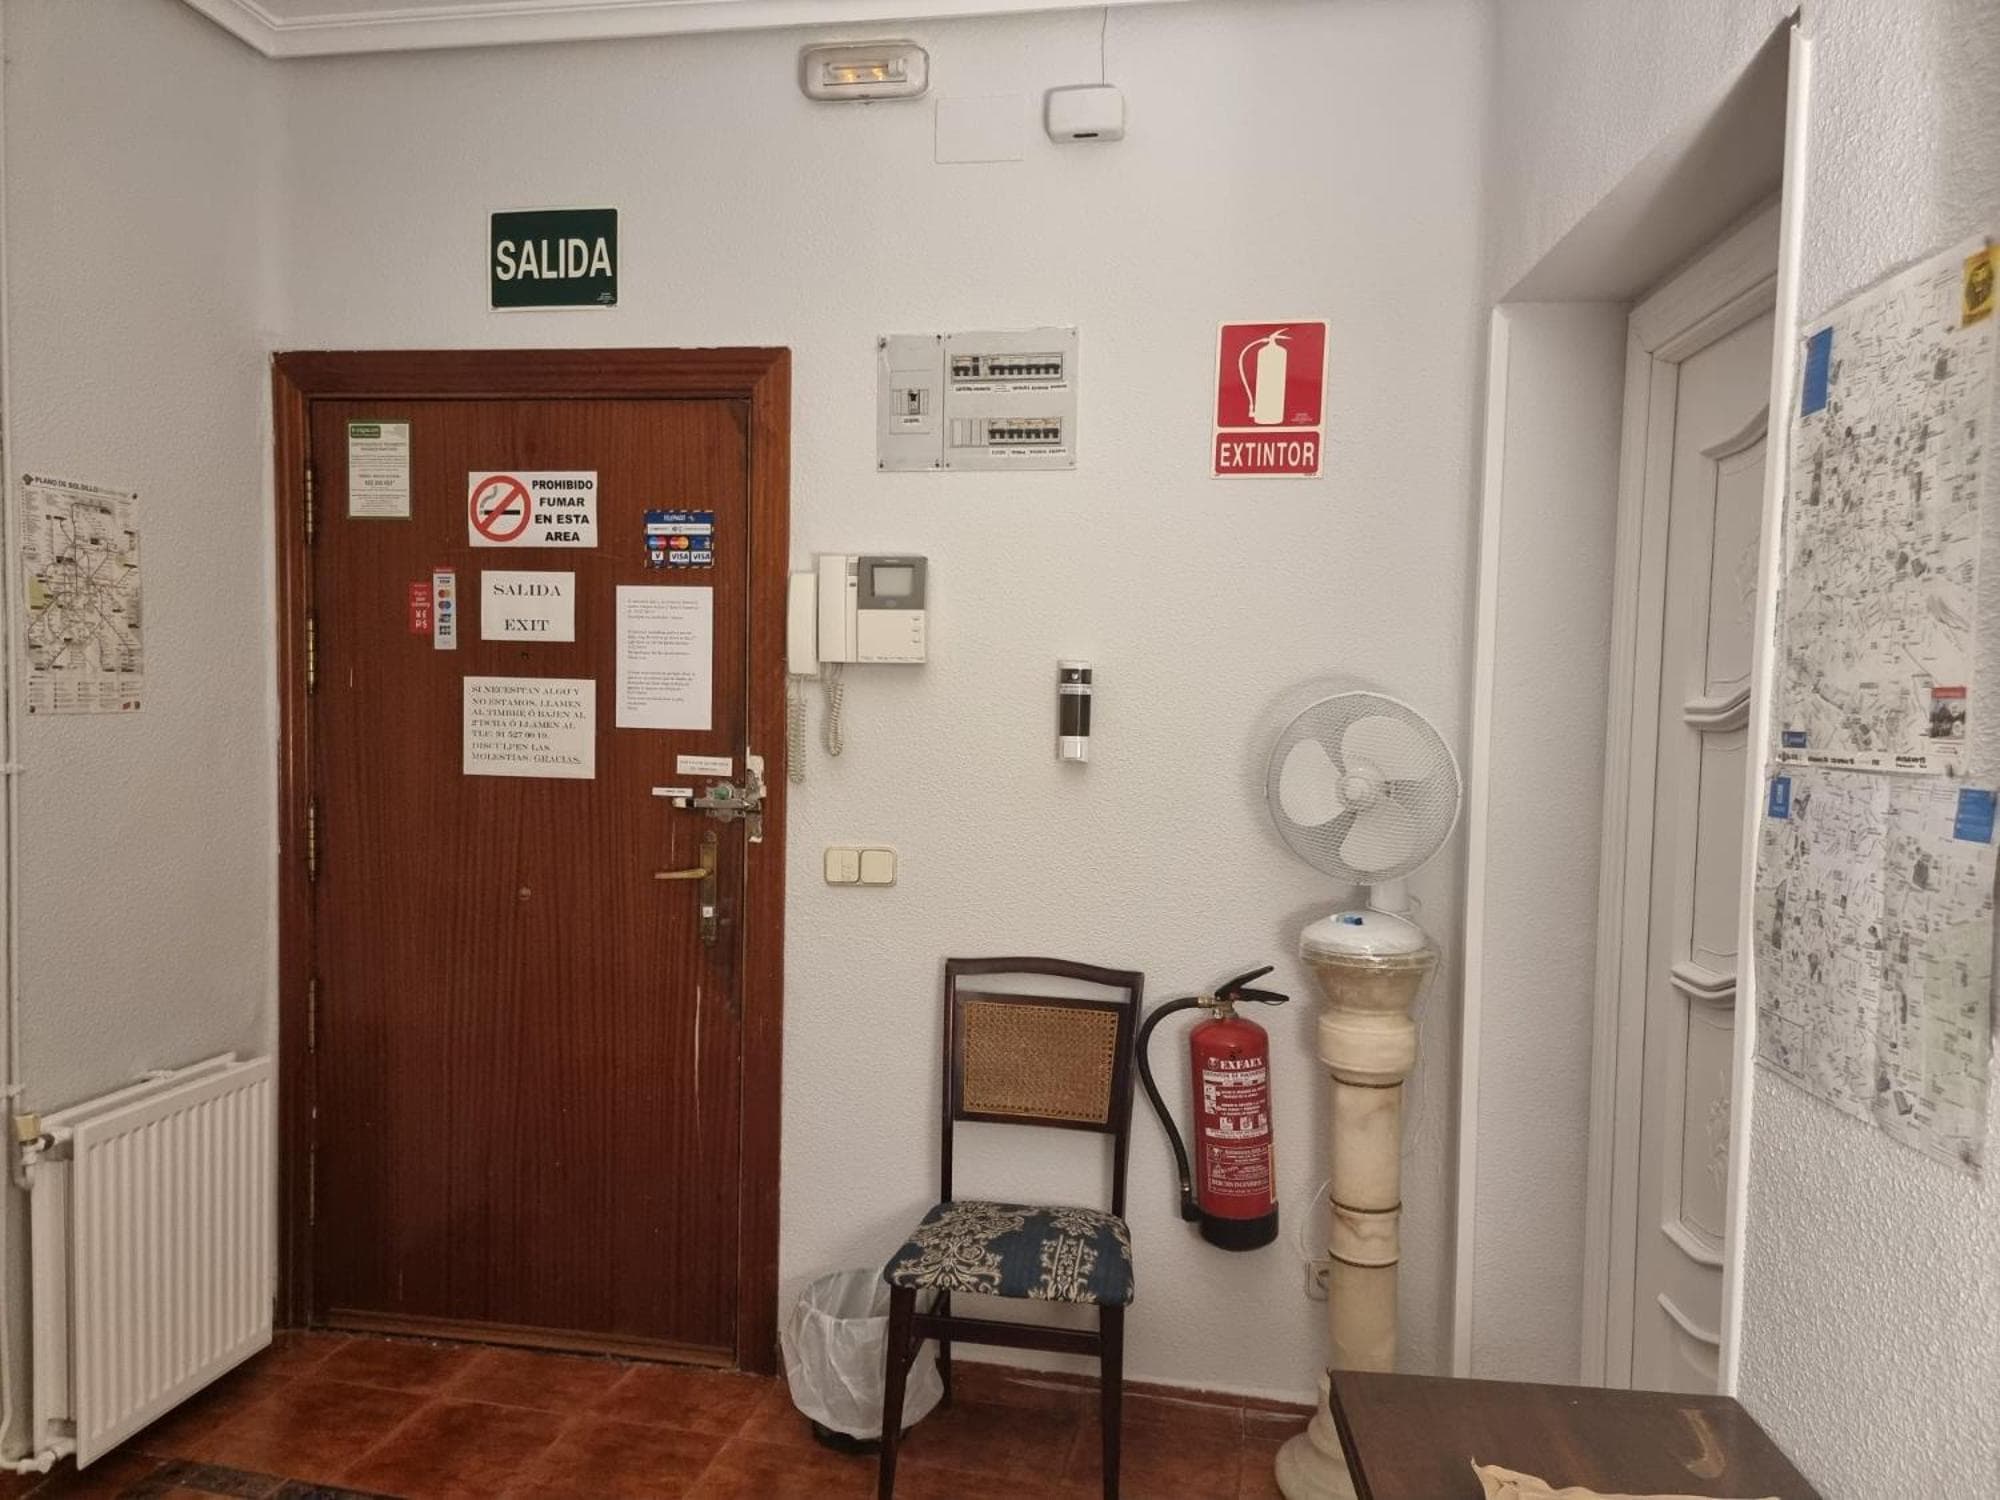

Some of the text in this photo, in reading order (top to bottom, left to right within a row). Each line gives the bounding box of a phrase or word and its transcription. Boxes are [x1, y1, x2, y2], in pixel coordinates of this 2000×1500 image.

[496, 237, 613, 281] SALIDA
[1220, 441, 1315, 467] EXTINTOR
[532, 480, 593, 490] PROHIBIDO
[539, 497, 585, 507] FUMAR
[535, 514, 590, 524] EN ESTA
[545, 531, 580, 541] AREA
[672, 553, 689, 561] VISA
[692, 553, 710, 561] VISA
[493, 583, 561, 597] SALIDA
[504, 618, 550, 632] EXIT
[471, 686, 580, 696] SI NECESITAN ALGO Y
[472, 698, 487, 706] NO
[541, 700, 583, 709] LLAMEN
[472, 709, 484, 717] AL
[538, 711, 570, 719] BAJEN
[519, 721, 560, 729] LLAMEN
[507, 731, 523, 739] 527
[472, 742, 551, 752] DISCULPEN LAS
